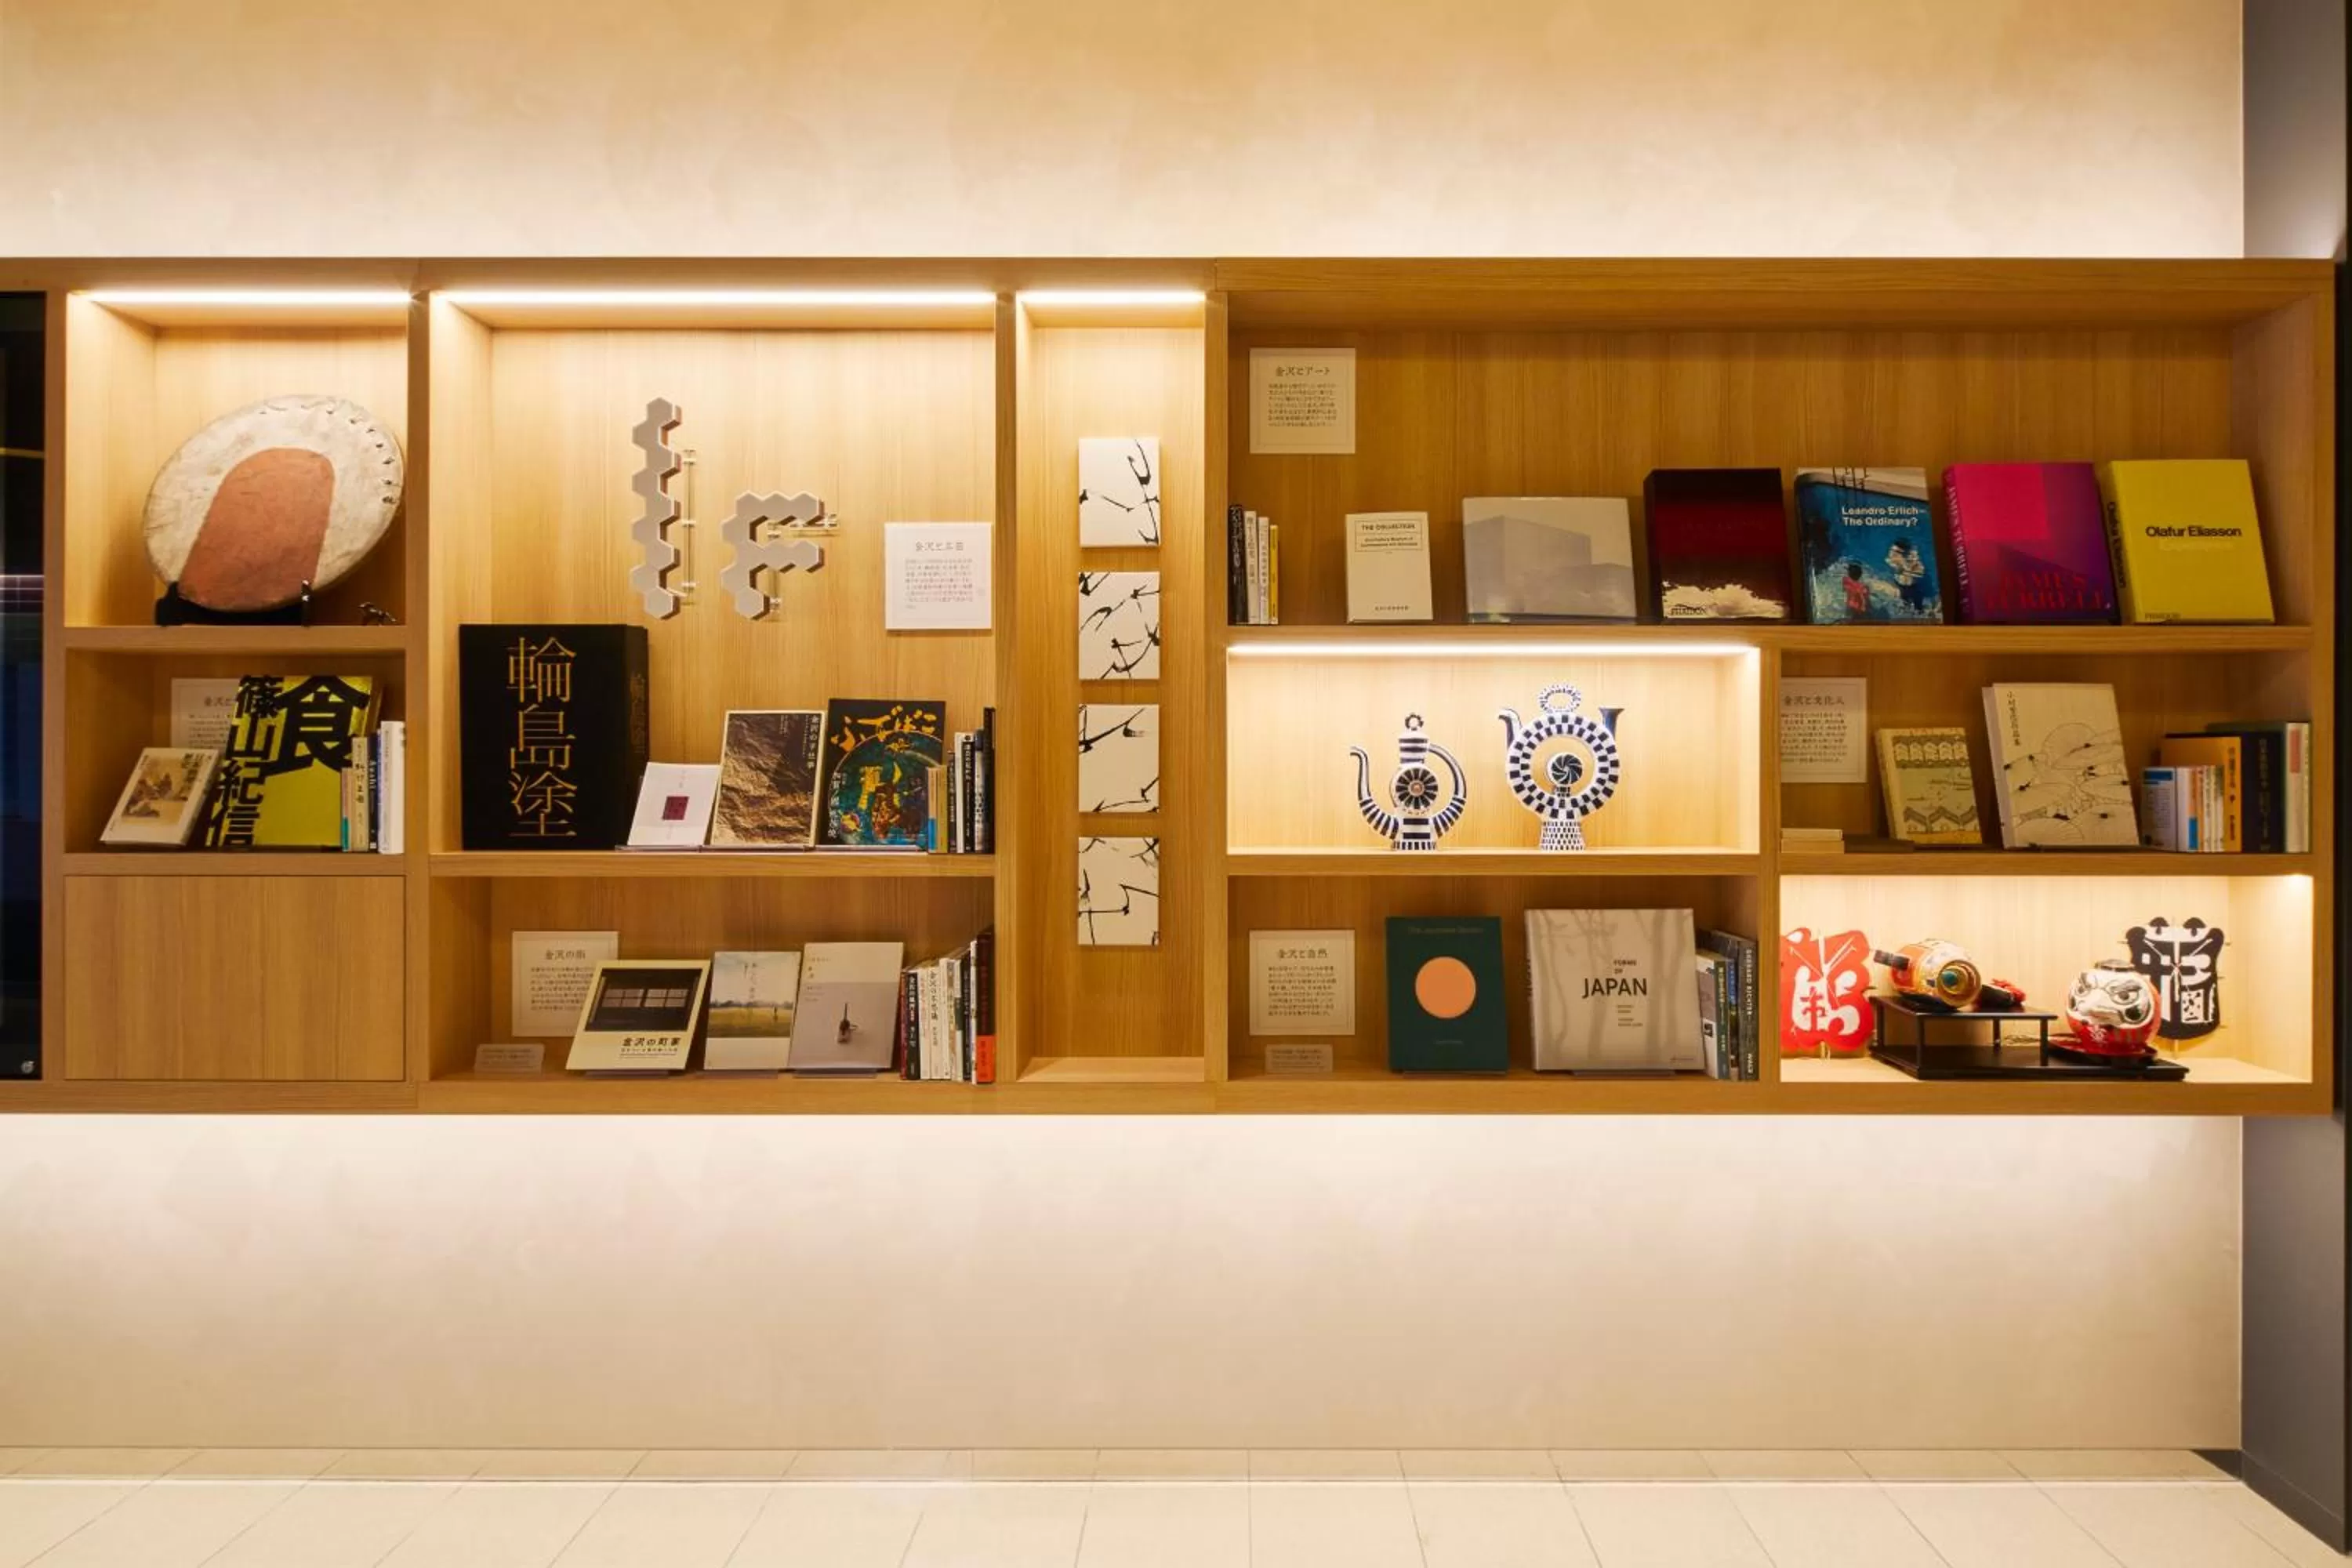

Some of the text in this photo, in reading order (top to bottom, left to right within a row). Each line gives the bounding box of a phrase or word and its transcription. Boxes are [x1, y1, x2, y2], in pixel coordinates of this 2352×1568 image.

[1842, 506, 1918, 515] Leandro Erlich
[1843, 517, 1918, 528] The Ordinary?
[2146, 525, 2242, 537] Olafur Eliasson
[266, 675, 372, 776] 食
[506, 637, 578, 837] 輪島塗
[205, 675, 286, 848] 篠山紀信
[1581, 978, 1647, 999] JAPAN
